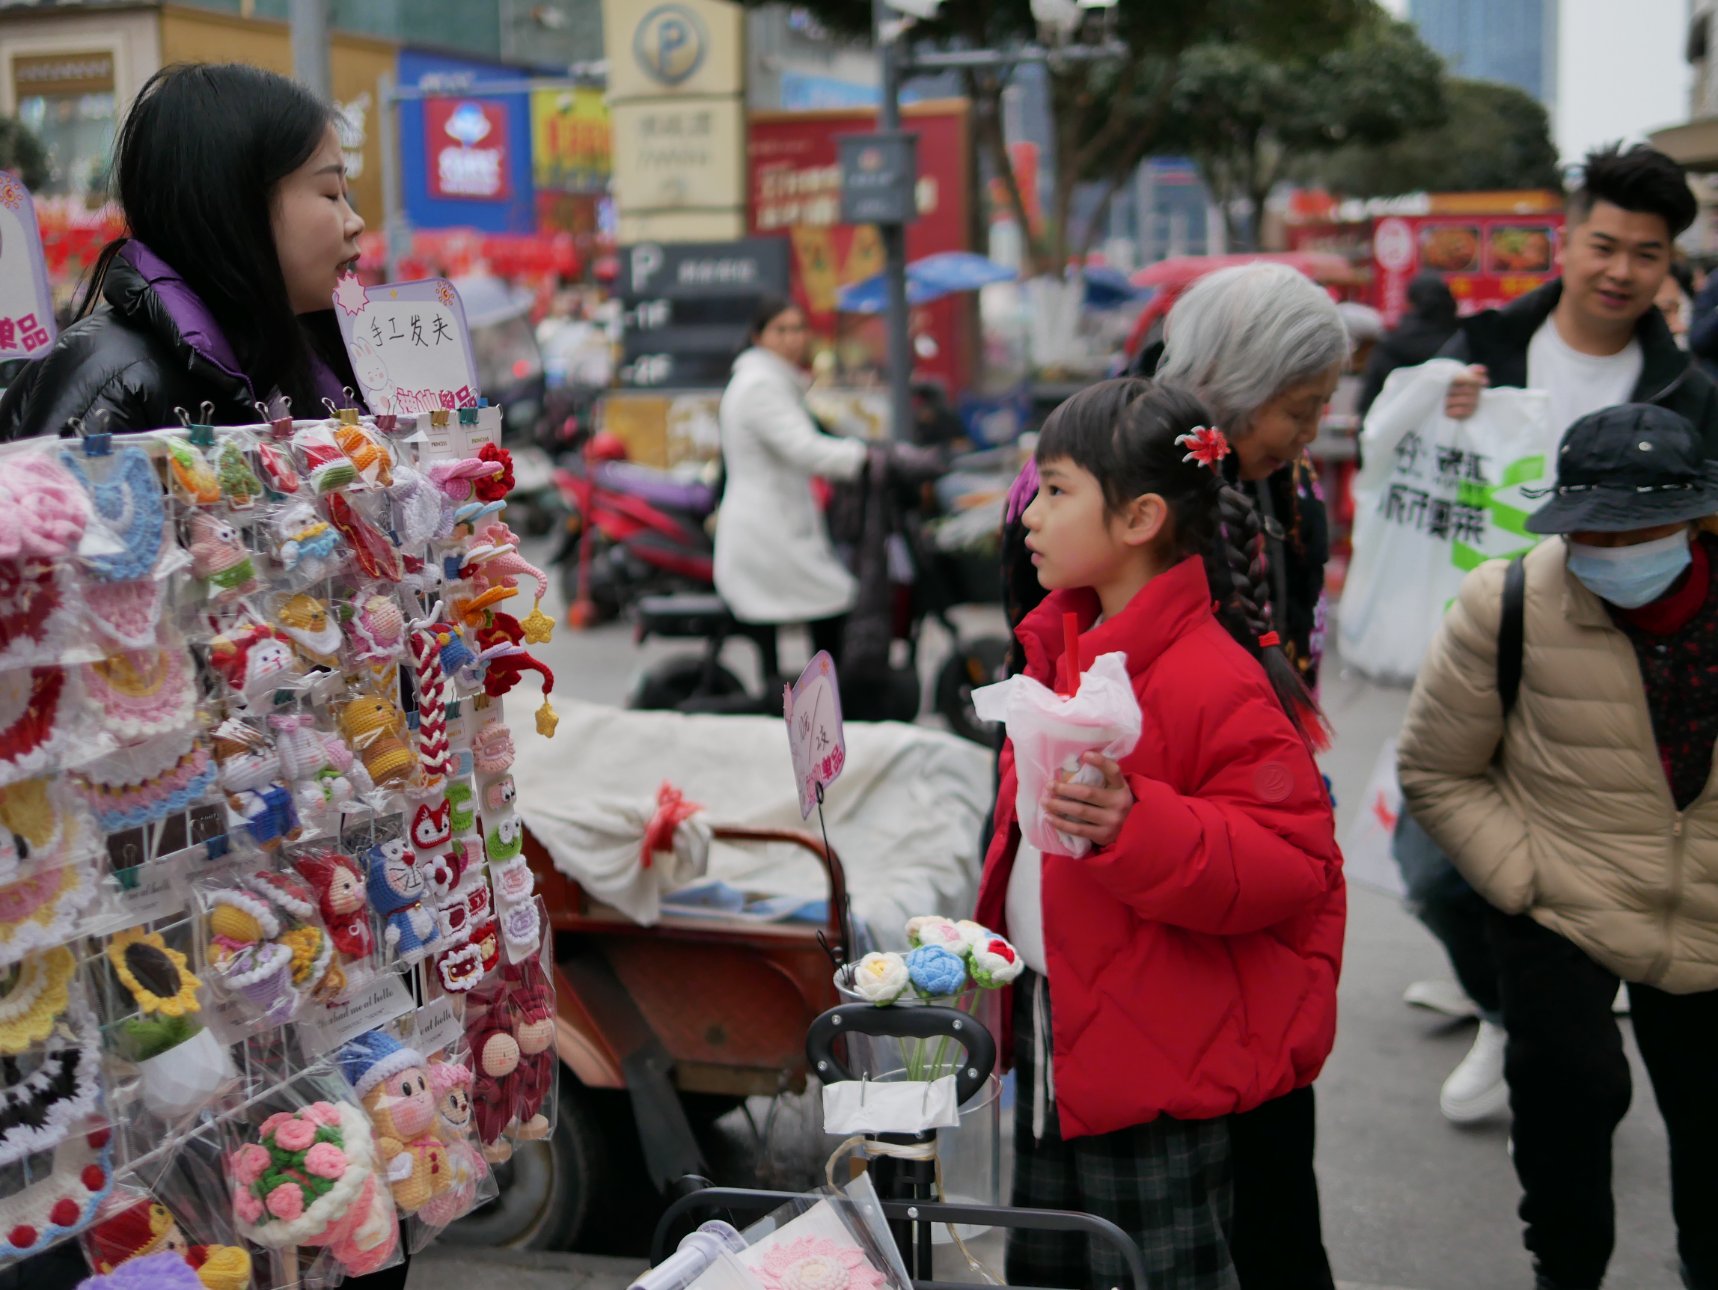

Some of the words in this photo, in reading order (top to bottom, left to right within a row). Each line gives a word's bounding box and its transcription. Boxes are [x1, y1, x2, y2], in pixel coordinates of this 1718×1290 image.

[370, 314, 453, 348] 手工发夹
[373, 987, 394, 1005] hello
